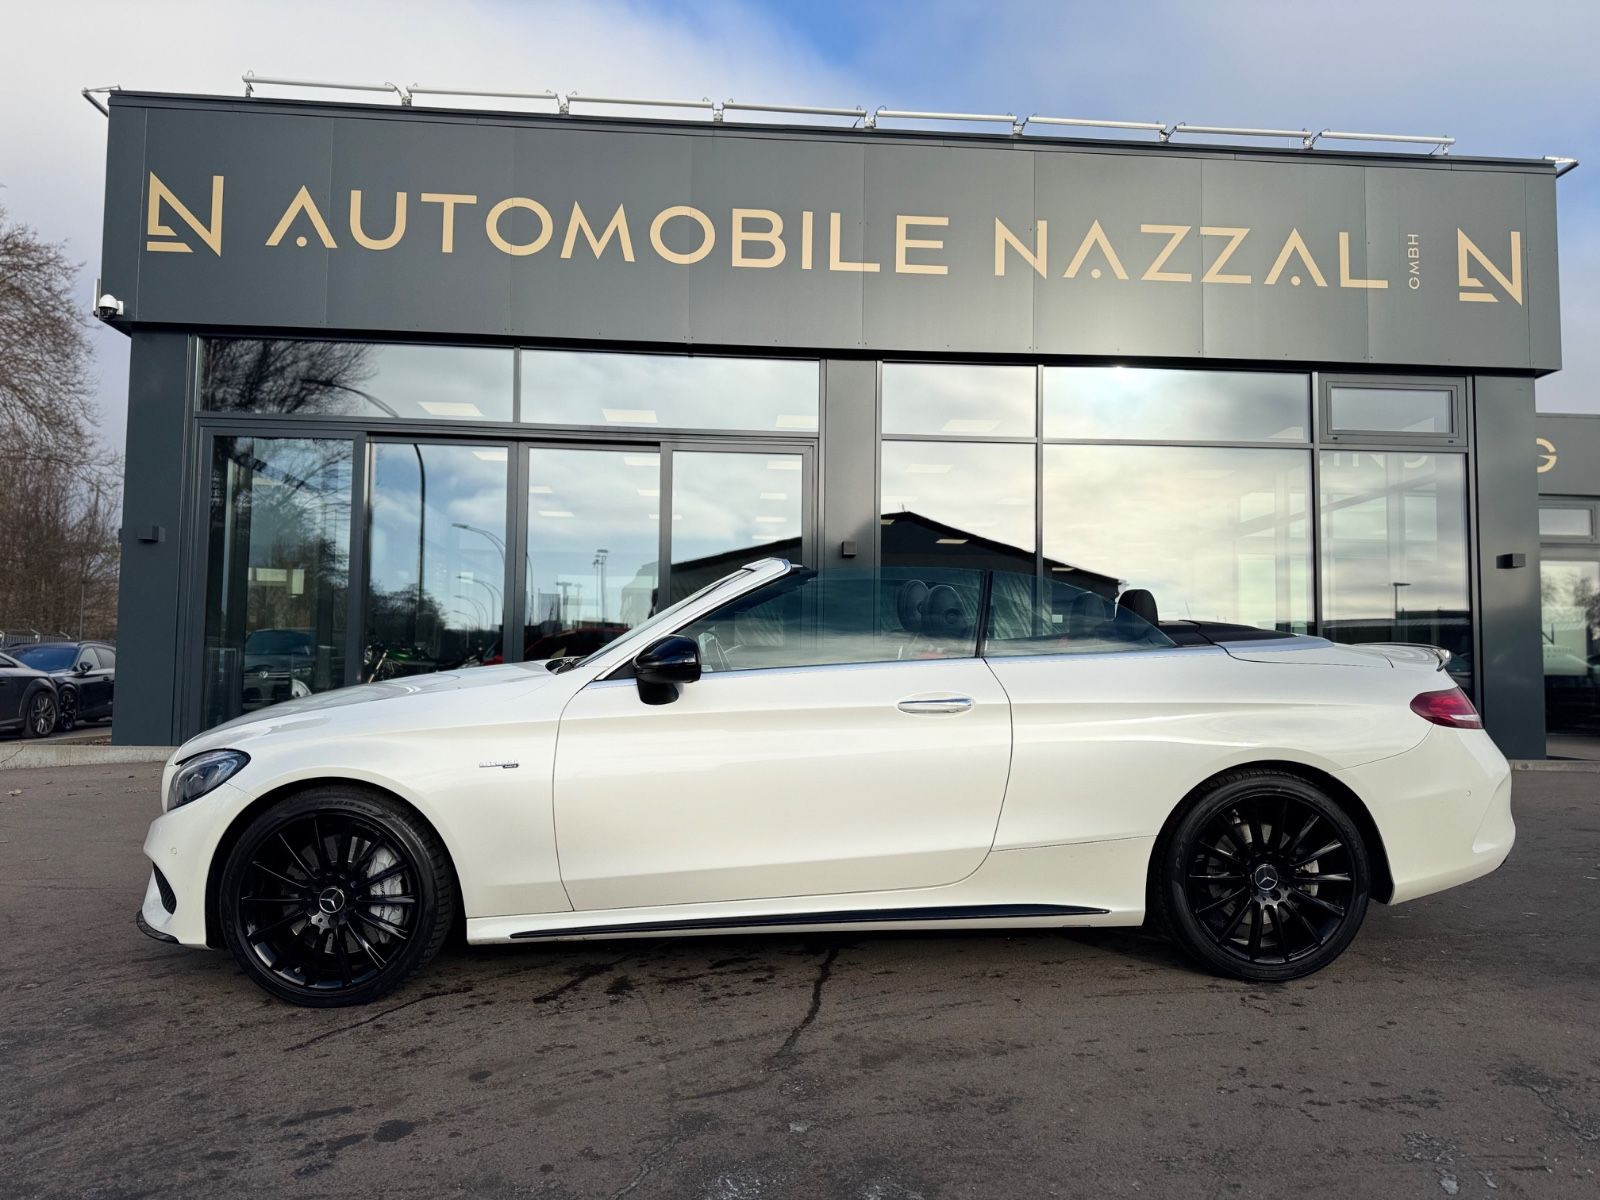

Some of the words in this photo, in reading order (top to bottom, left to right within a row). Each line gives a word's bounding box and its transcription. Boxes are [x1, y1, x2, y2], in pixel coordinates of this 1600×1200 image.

[266, 186, 950, 277] AUTOMOBILE
[994, 217, 1389, 289] NAZZAL
[1407, 233, 1420, 290] GMBH
